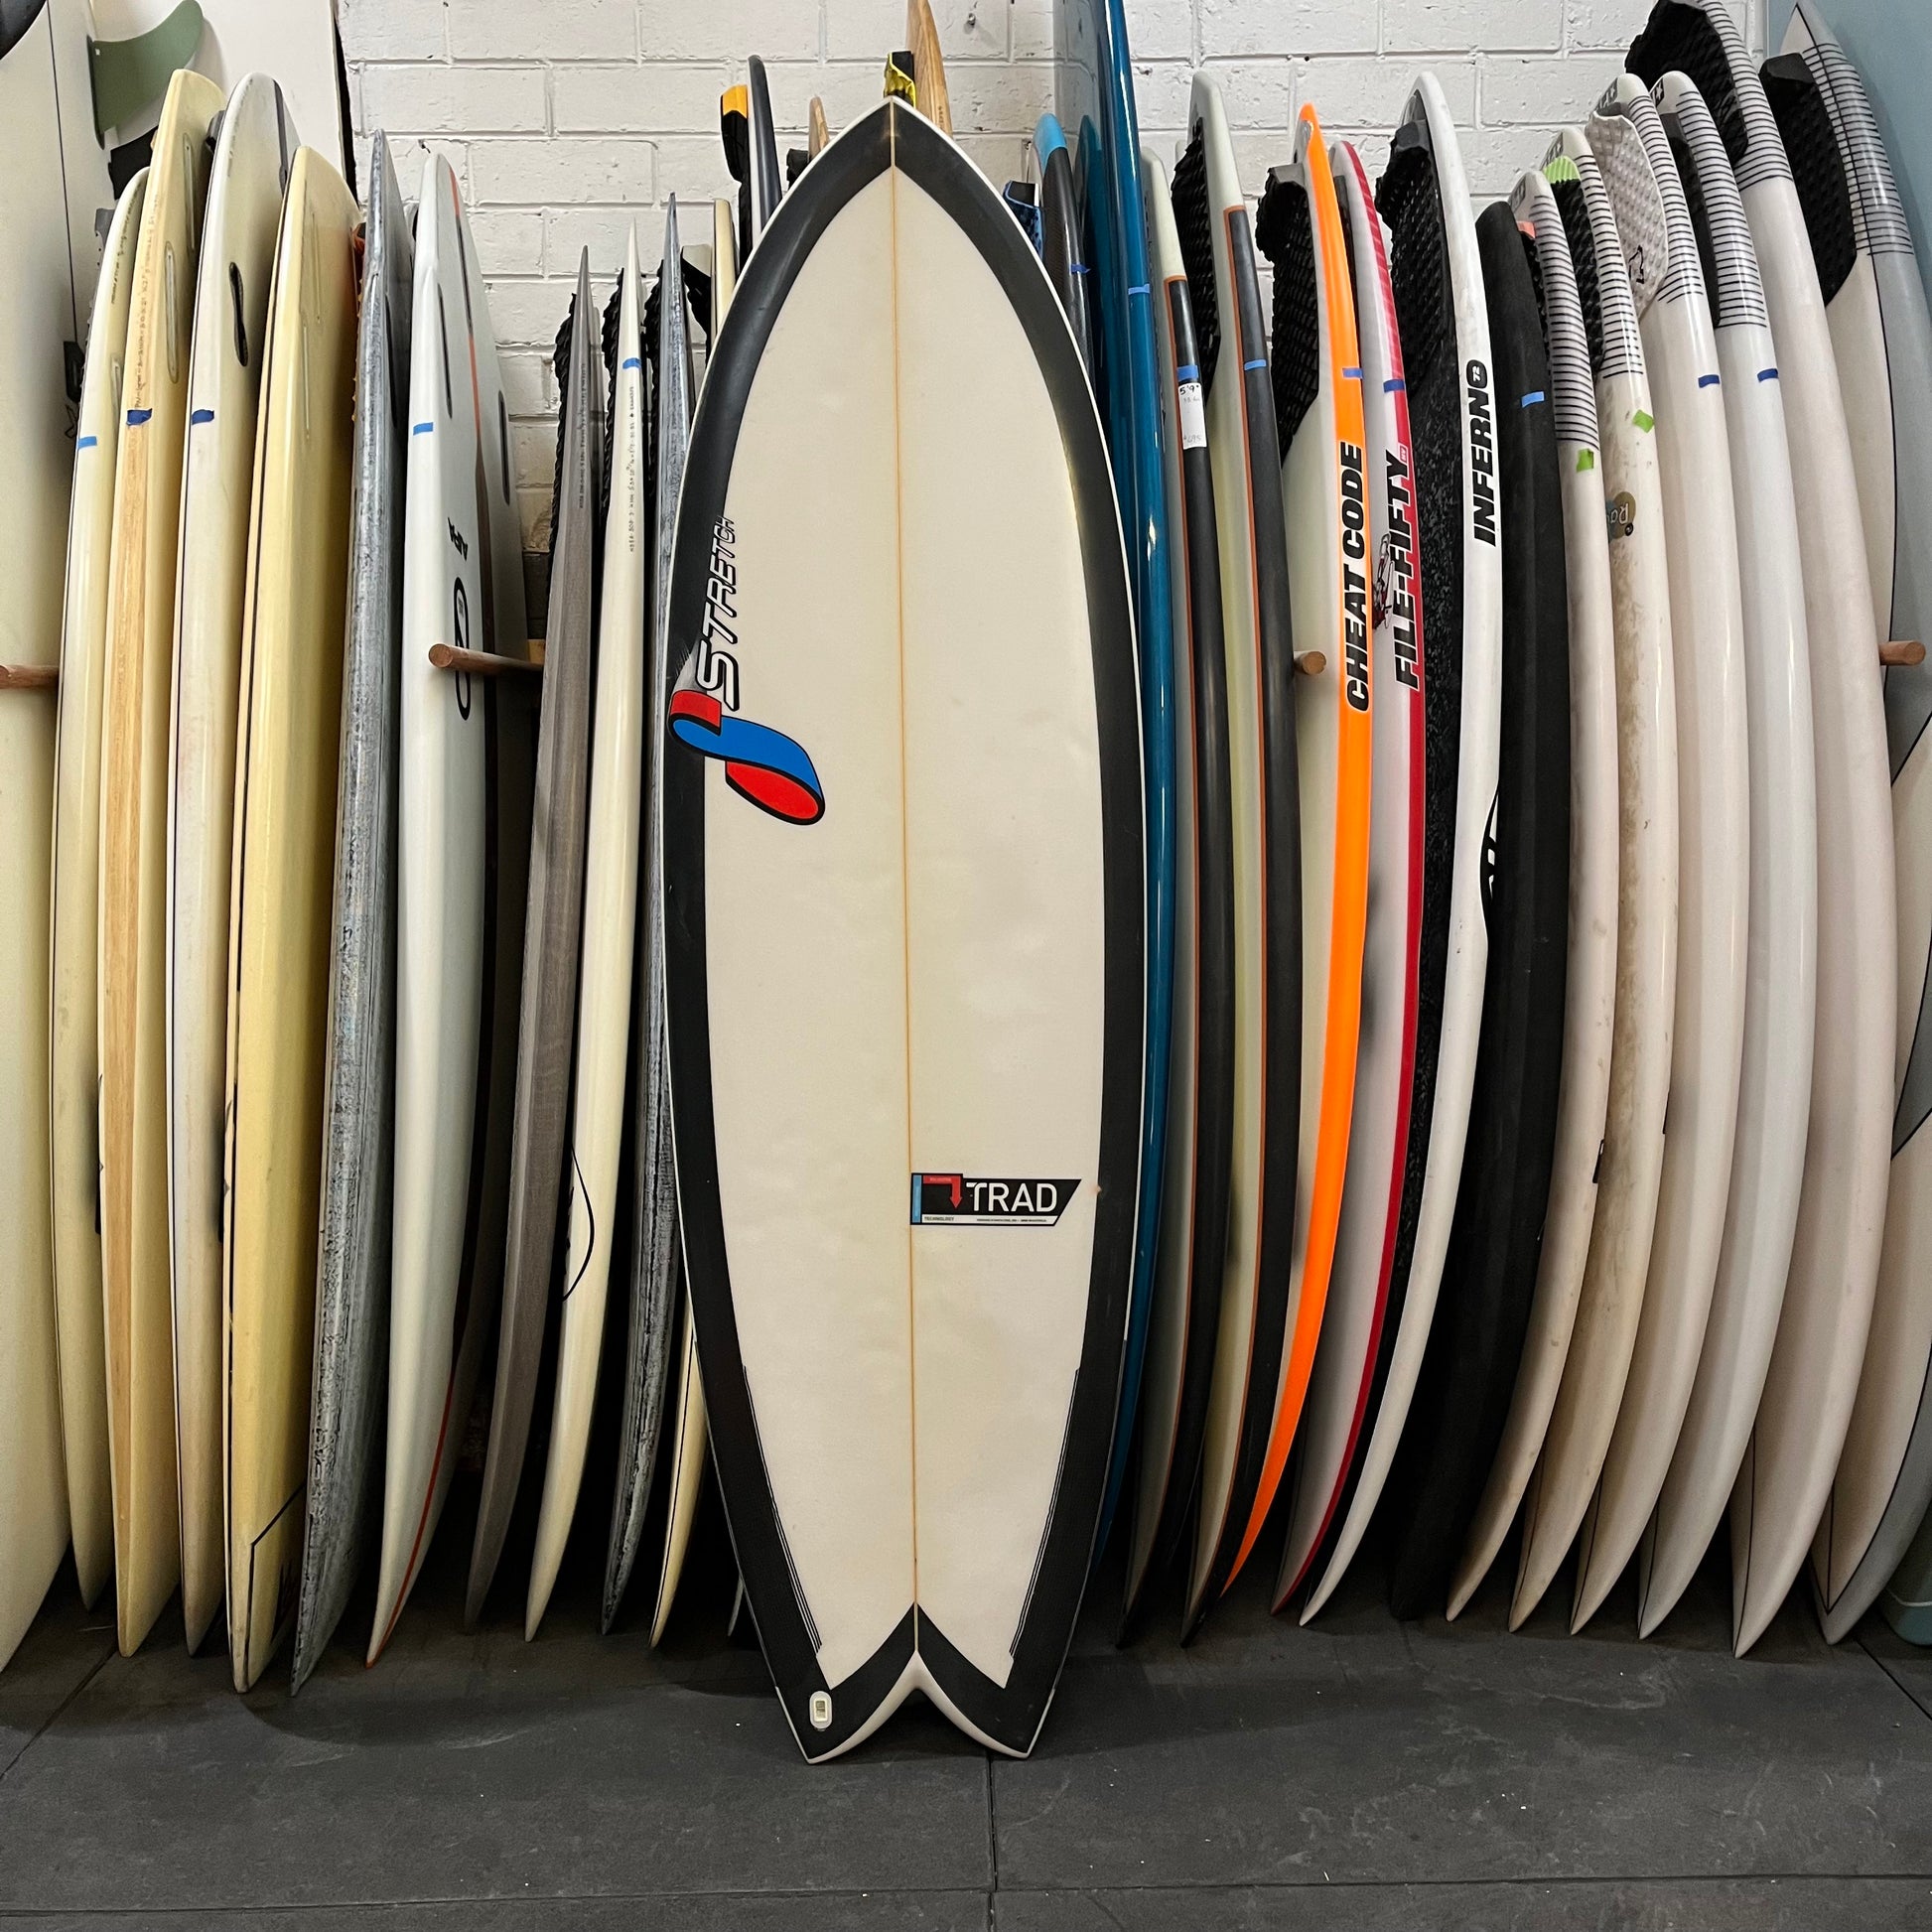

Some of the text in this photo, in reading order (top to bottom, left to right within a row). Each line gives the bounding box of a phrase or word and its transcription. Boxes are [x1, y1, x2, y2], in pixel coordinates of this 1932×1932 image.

[1466, 359, 1496, 547] INFERNO
[1472, 365, 1480, 381] 72
[696, 515, 740, 712] STRETCH
[1340, 441, 1370, 712] CHEAT CODE
[1386, 449, 1420, 690] FILE-FIFTY
[965, 1182, 1057, 1212] TRAD
